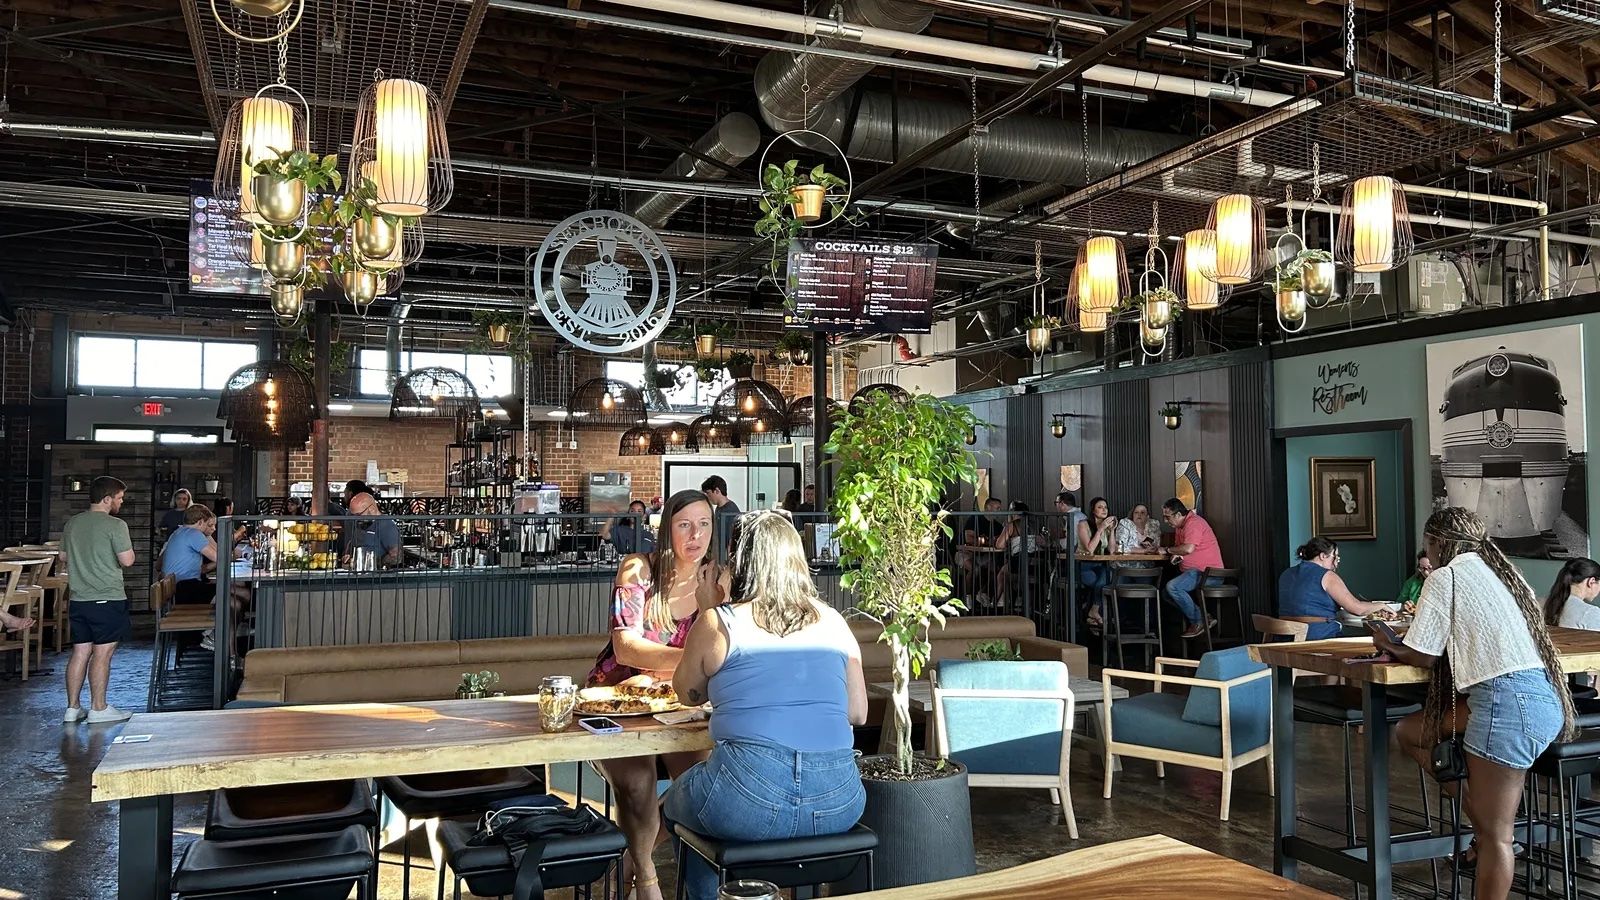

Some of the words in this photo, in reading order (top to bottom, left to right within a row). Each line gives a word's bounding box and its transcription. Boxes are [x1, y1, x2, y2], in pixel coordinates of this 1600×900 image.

[815, 241, 890, 254] COCKTAILS
[893, 244, 914, 255] $12
[554, 309, 592, 344] EST.
[619, 315, 661, 344] 2016
[143, 403, 162, 415] EXIT
